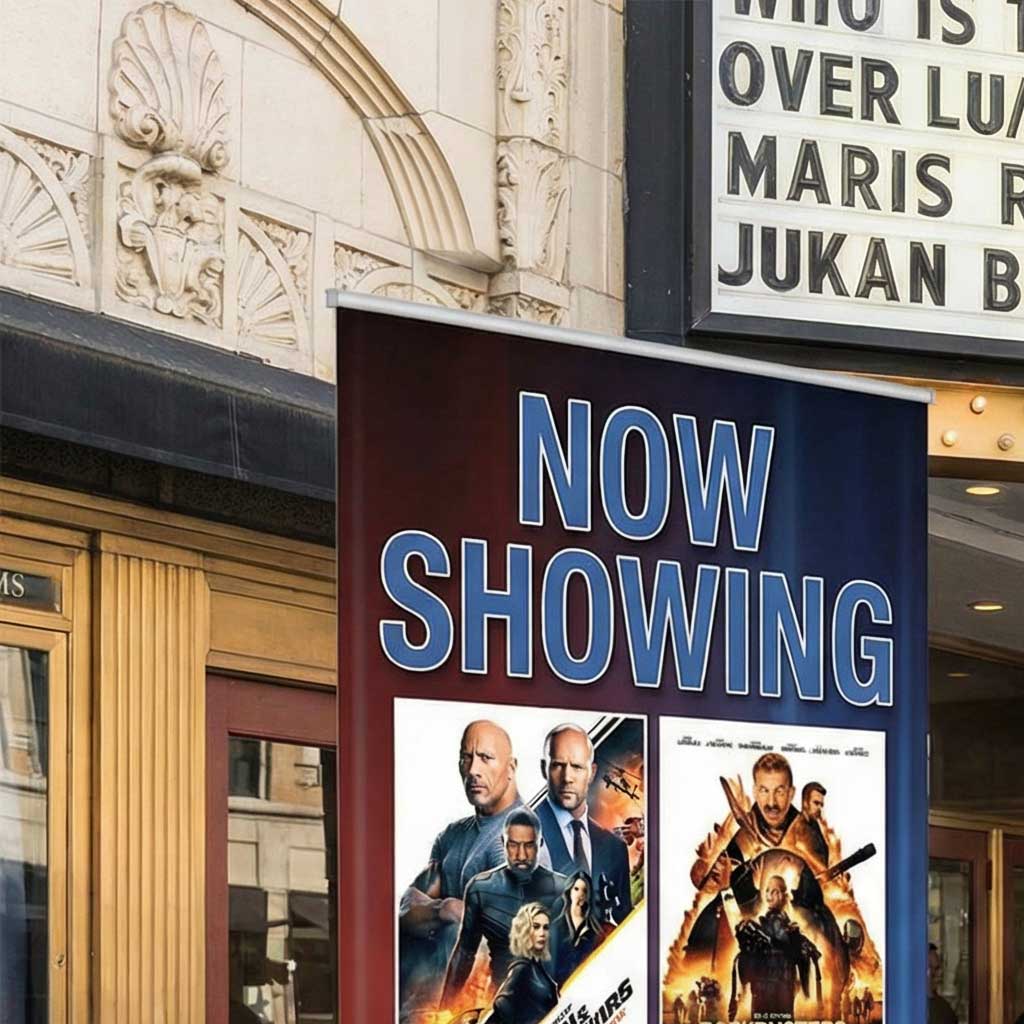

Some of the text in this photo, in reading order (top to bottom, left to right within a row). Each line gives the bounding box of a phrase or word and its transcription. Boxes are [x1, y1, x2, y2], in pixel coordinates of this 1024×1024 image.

[718, 41, 901, 125] OVER
[727, 131, 953, 218] MARIS
[717, 222, 946, 307] JUKAN
[518, 390, 775, 552] NOW
[379, 529, 894, 708] SHOWING
